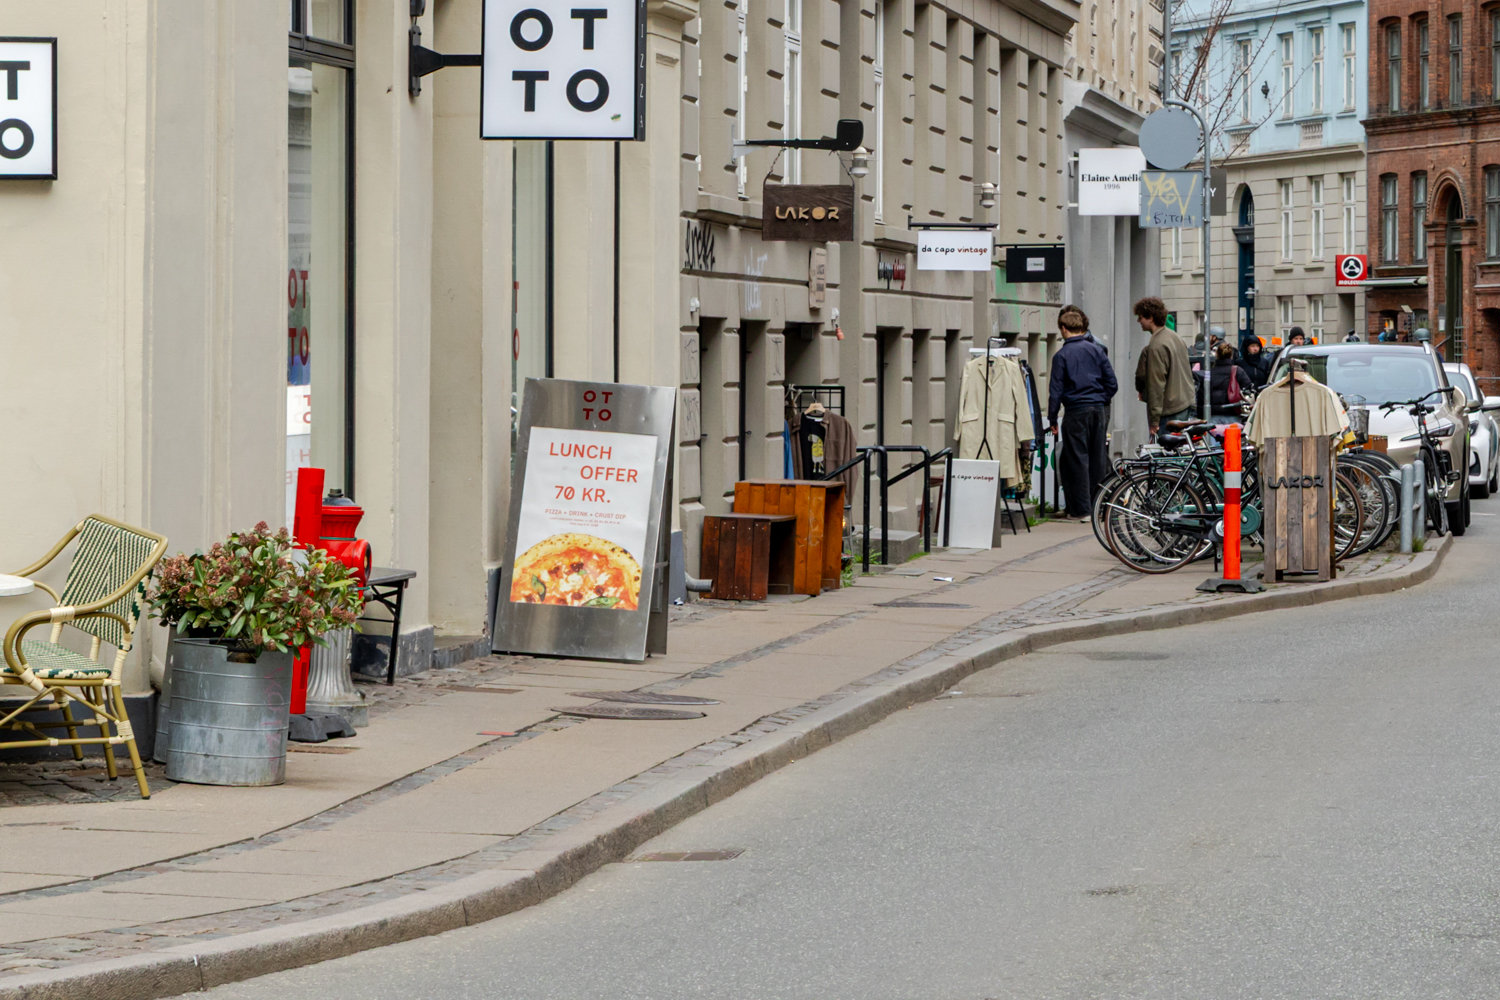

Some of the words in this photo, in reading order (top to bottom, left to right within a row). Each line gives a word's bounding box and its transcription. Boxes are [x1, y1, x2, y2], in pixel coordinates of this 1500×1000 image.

[510, 8, 608, 51] OT
[0, 60, 31, 100] T
[512, 69, 610, 112] TO
[0, 118, 34, 160] O
[1081, 173, 1110, 182] Elaine
[775, 206, 840, 220] LAKOR
[921, 244, 932, 253] da
[935, 247, 955, 256] capo
[957, 244, 988, 256] vintage
[287, 268, 309, 309] OT
[288, 326, 309, 366] TO
[583, 390, 613, 404] OT
[583, 408, 612, 421] TO
[549, 442, 612, 460] LUNCH
[580, 465, 638, 483] OFFER
[1268, 475, 1324, 489] LAKOR
[554, 485, 575, 500] 70
[582, 488, 611, 504] KR.
